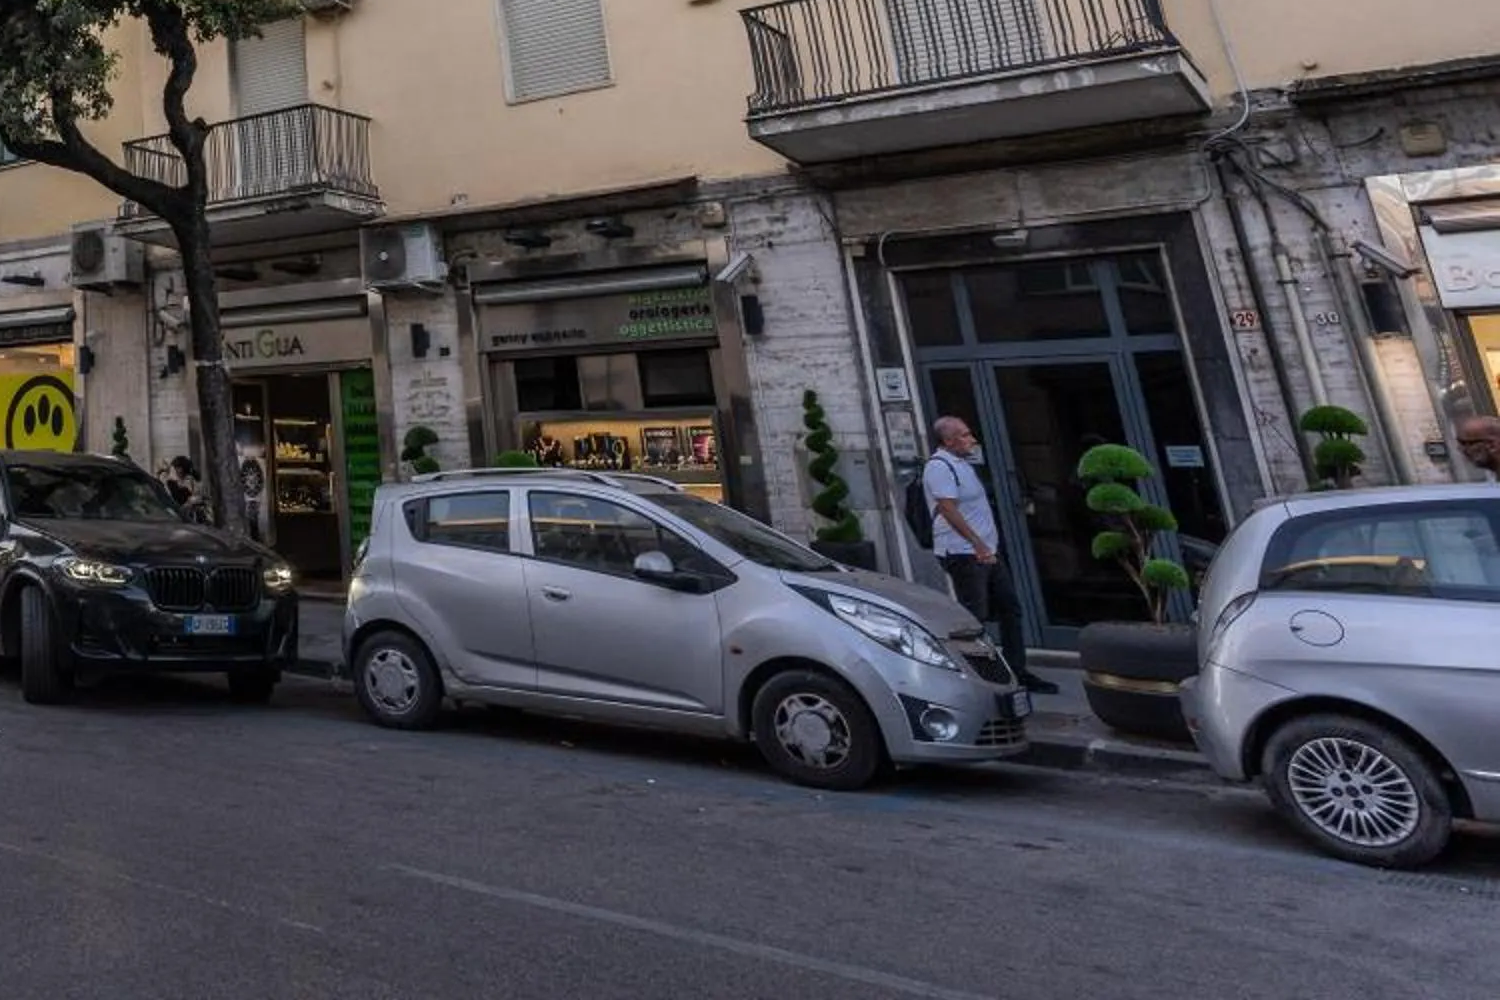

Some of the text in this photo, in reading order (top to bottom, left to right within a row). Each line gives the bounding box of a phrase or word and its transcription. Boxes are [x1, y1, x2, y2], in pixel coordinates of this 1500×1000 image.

[619, 318, 713, 337] oggettistica
[1235, 311, 1256, 327] 29
[221, 329, 304, 358] NTIGUA
